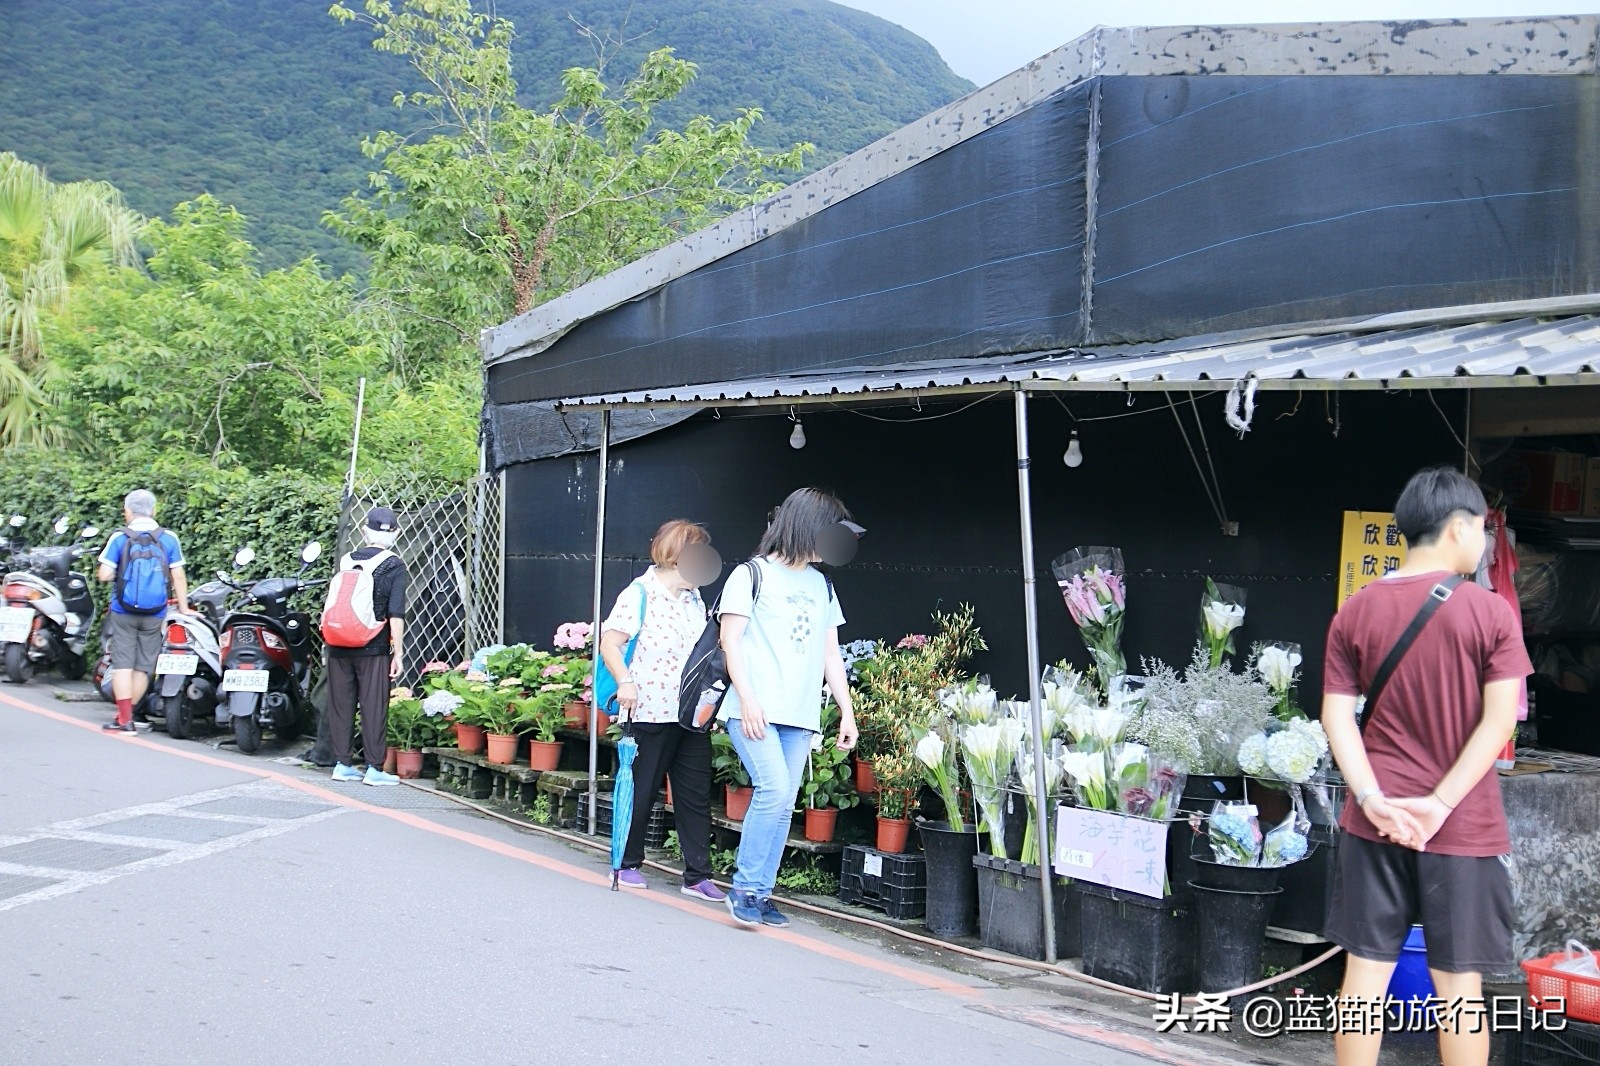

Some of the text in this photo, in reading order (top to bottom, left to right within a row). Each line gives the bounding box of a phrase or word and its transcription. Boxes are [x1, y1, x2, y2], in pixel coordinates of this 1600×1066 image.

[1361, 523, 1380, 589] 欣欣
[1384, 523, 1402, 576] 歡迎
[1080, 812, 1157, 853] 海芋花
[1135, 859, 1163, 887] 一束
